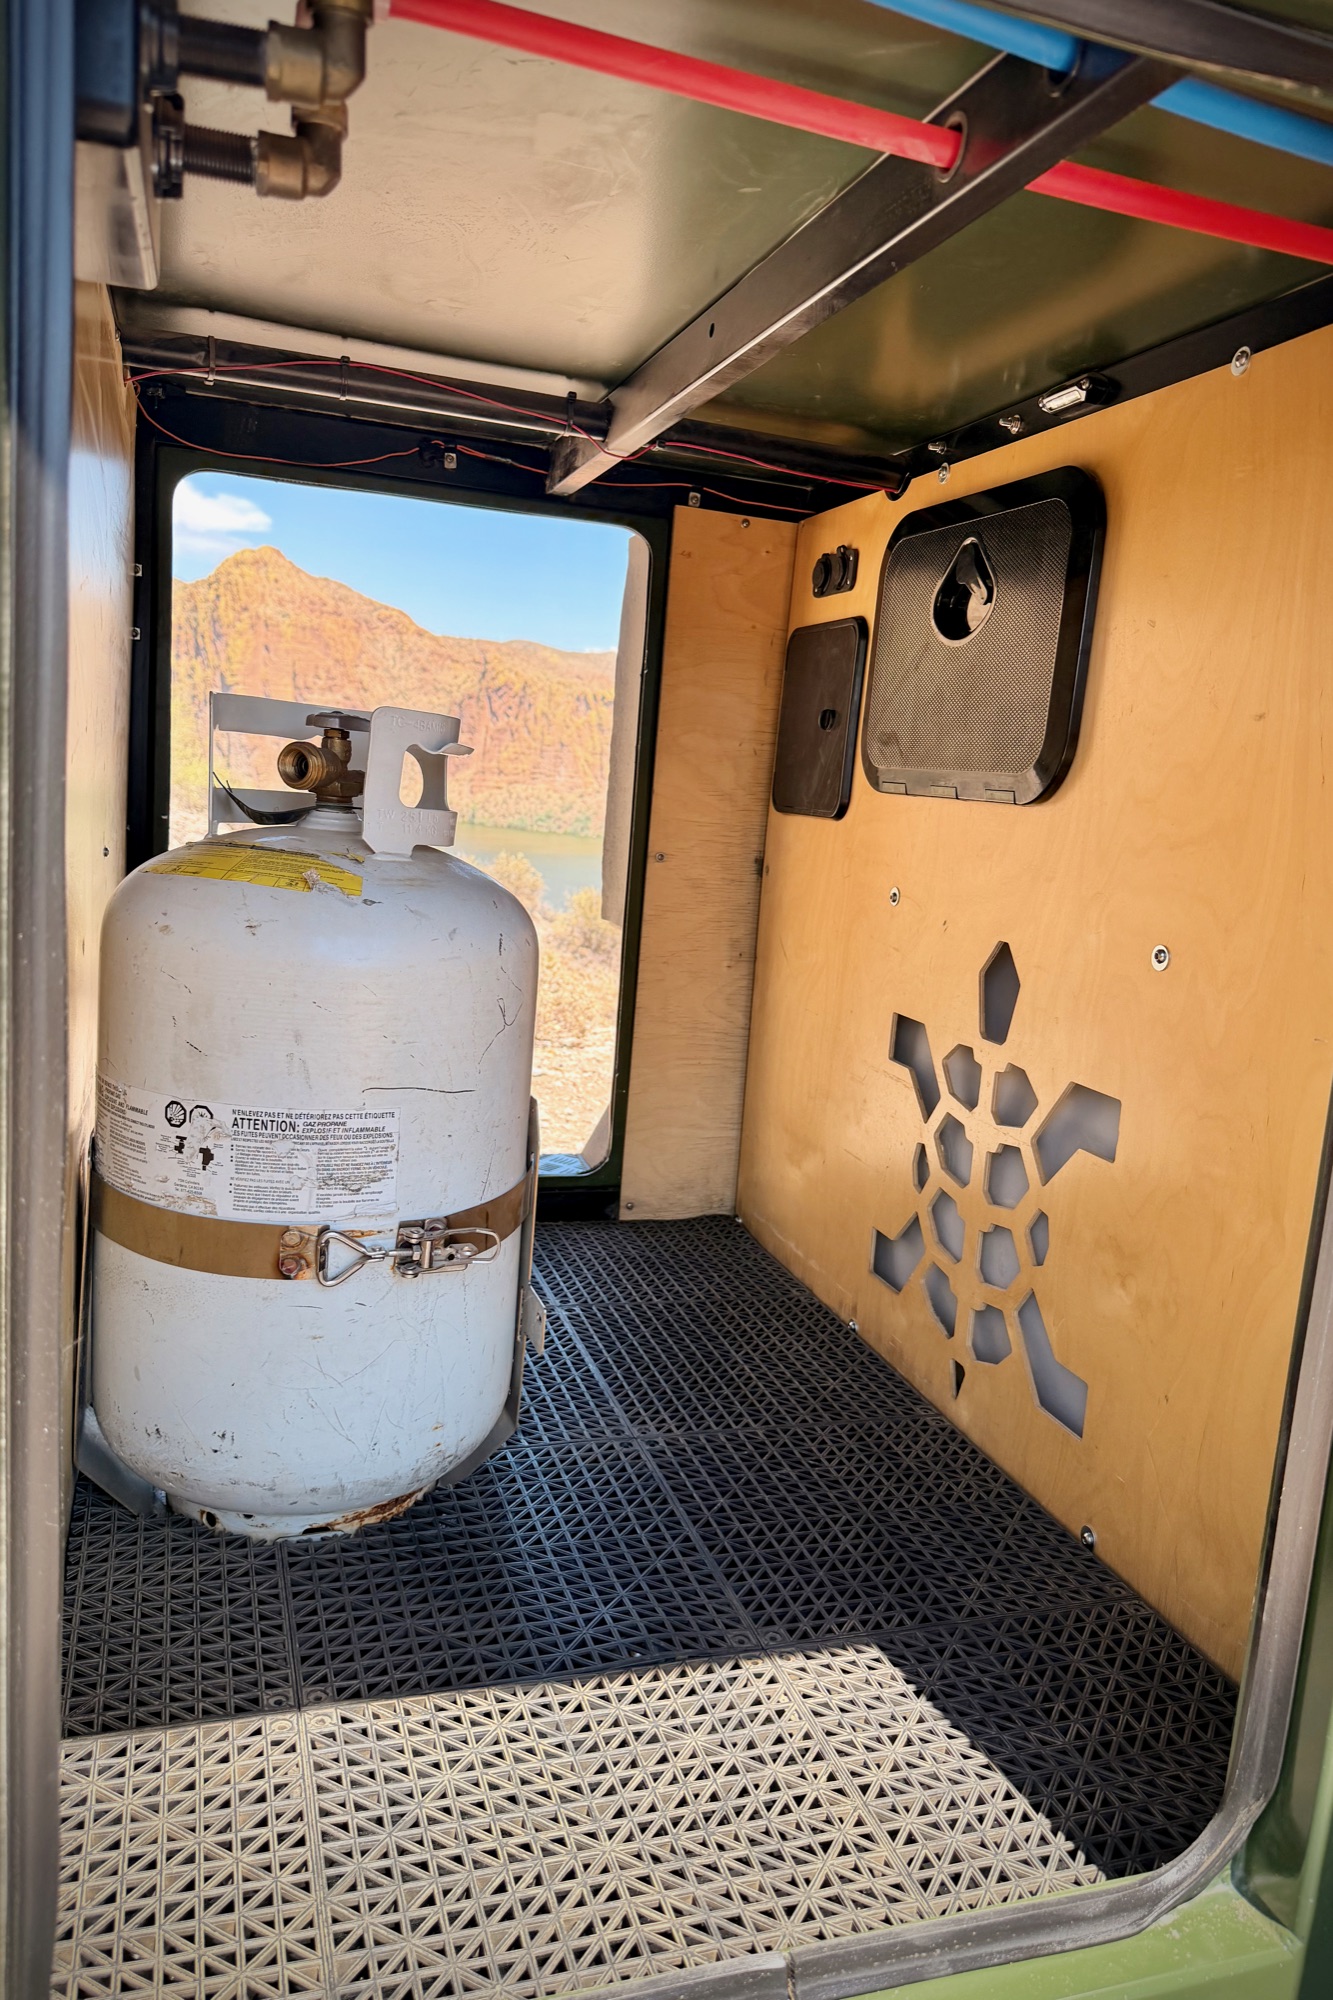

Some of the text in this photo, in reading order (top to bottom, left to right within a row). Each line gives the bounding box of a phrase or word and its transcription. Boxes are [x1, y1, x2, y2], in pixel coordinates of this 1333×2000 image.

[126, 1104, 149, 1116] FLAMMABLE
[232, 1108, 263, 1118] N'ENLEVEZ
[295, 1112, 331, 1120] DÉTÉRIOREZ
[364, 1111, 395, 1119] ÉTIQUETTE
[232, 1117, 300, 1133] ATTENTION:
